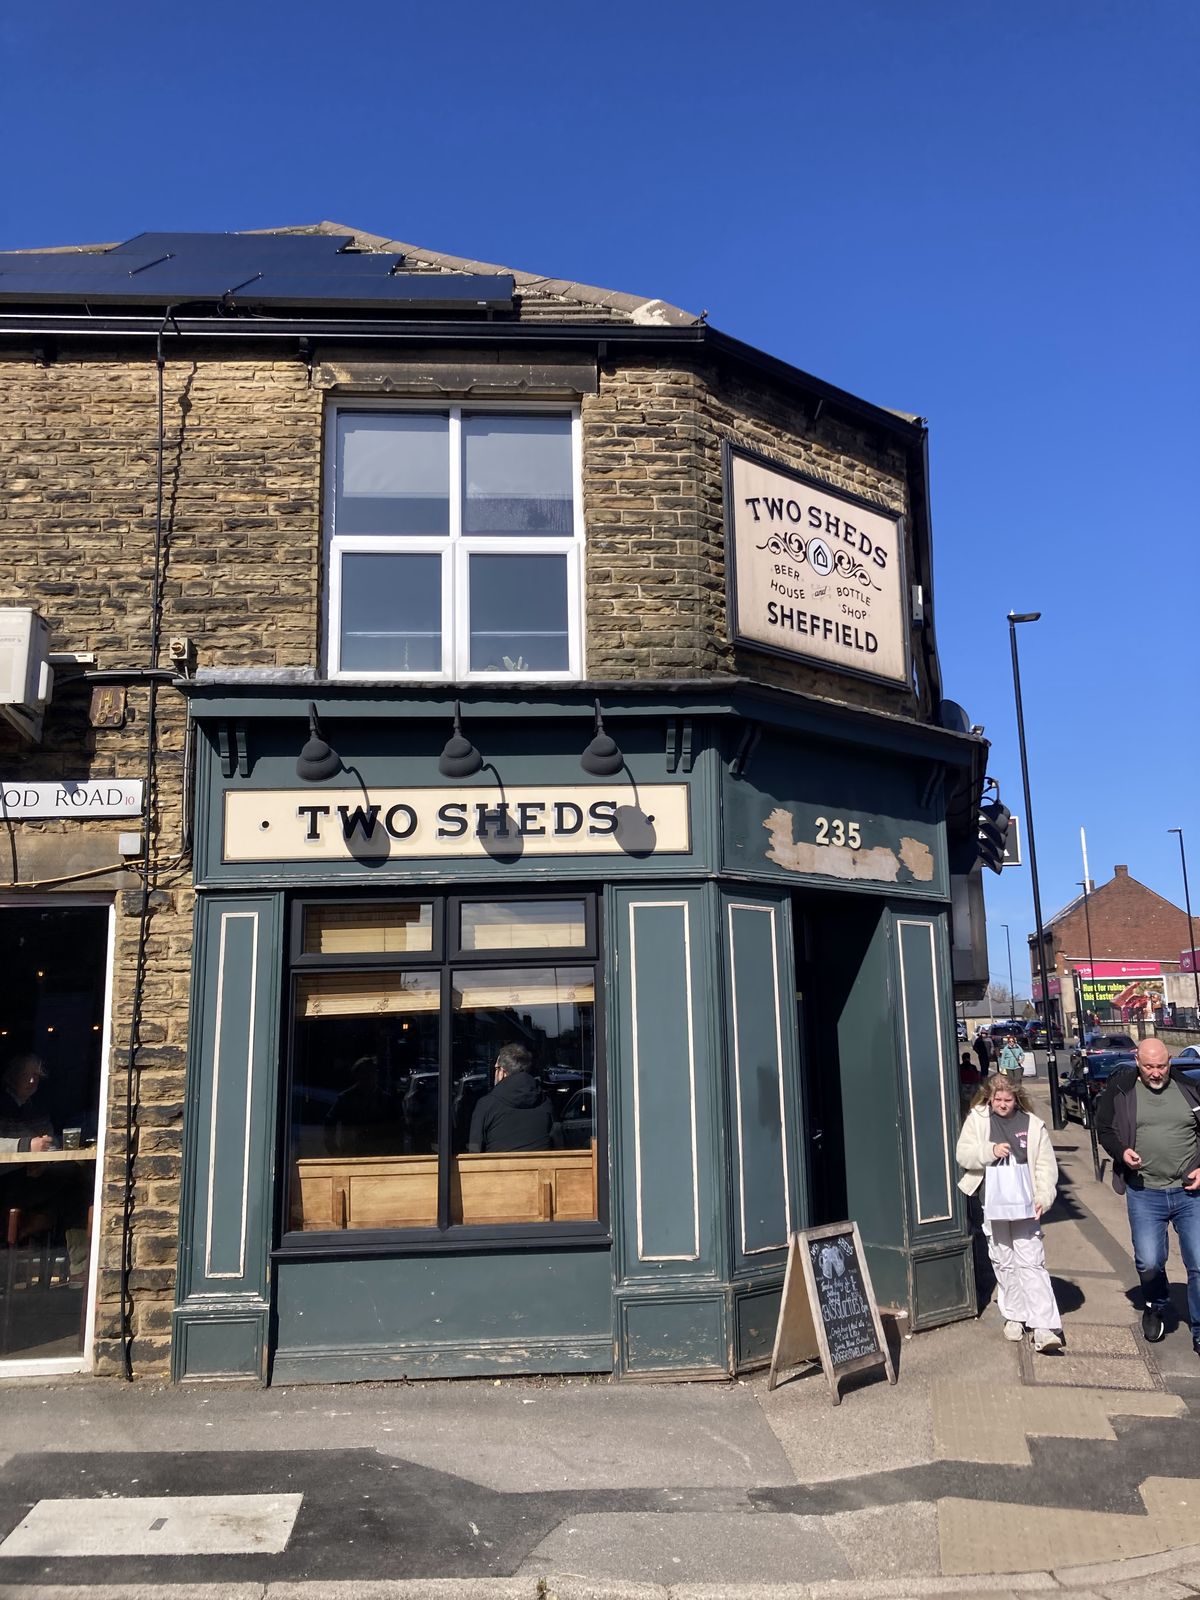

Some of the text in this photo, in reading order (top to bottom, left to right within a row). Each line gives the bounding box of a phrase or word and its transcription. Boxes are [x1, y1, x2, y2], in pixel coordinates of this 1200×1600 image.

[745, 497, 888, 569] TWO SHEDS
[774, 564, 801, 581] BEER
[770, 579, 872, 607] HOUSE and BOTTLE
[841, 603, 867, 620] SHOP
[767, 601, 878, 654] SHEFFIELD
[0, 789, 40, 808] OD
[55, 788, 123, 807] ROAD
[297, 800, 620, 841] TWO SHEDS
[815, 816, 862, 850] 235
[1083, 984, 1097, 992] Hunt
[1097, 983, 1107, 992] for
[1083, 992, 1095, 1001] this
